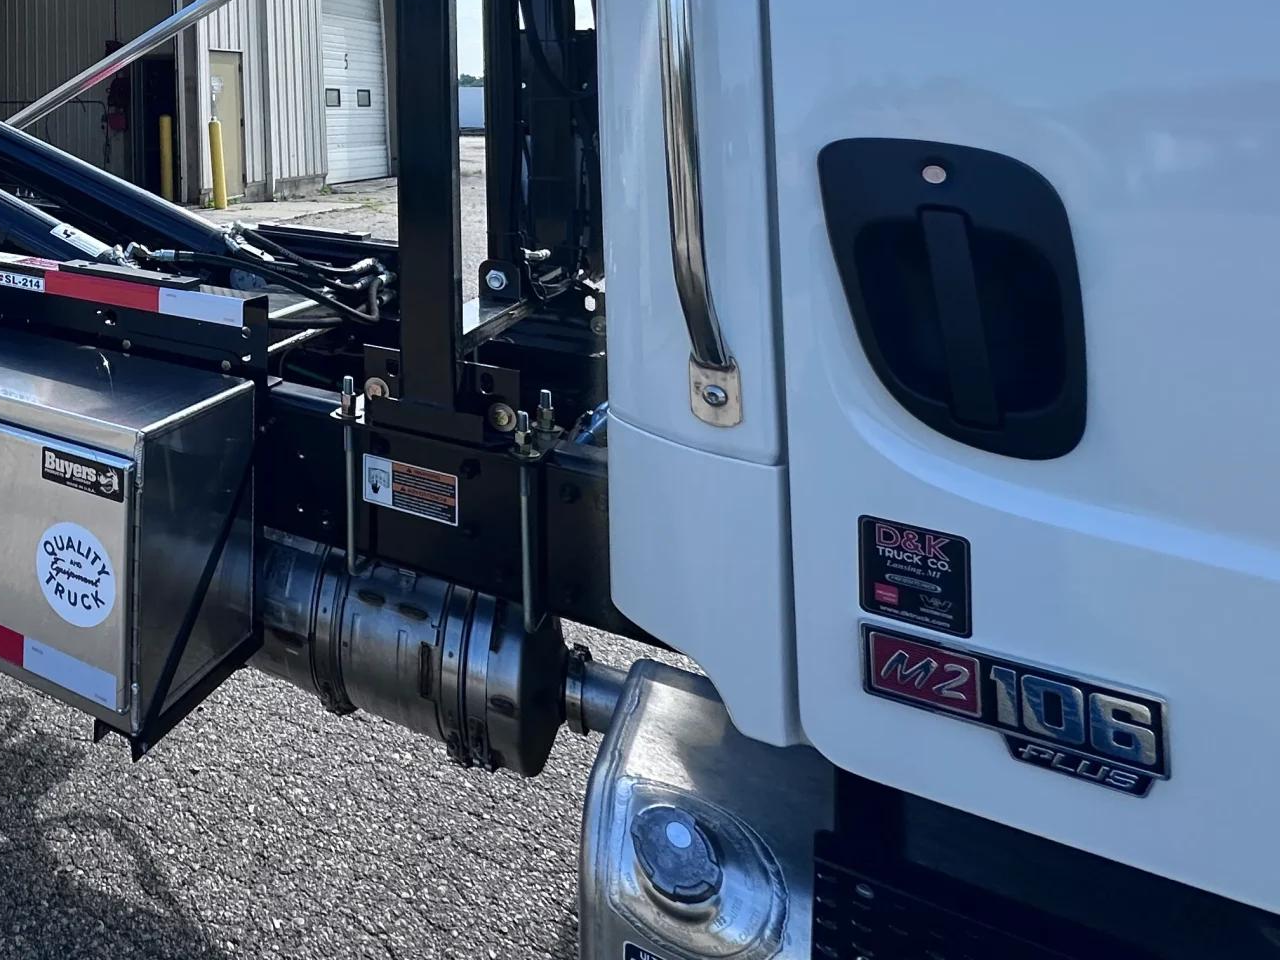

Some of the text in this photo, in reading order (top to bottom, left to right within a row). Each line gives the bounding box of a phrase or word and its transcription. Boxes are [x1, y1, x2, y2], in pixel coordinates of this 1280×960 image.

[44, 450, 97, 483] Buyers
[43, 535, 111, 577] QUALITY
[875, 523, 951, 562] D&K
[875, 545, 952, 573] TRUCK CO.
[886, 559, 941, 579] Lansing, MI
[45, 570, 106, 610] TRUCK
[880, 649, 1157, 766] M2 106
[1018, 743, 1139, 789] PLUS
